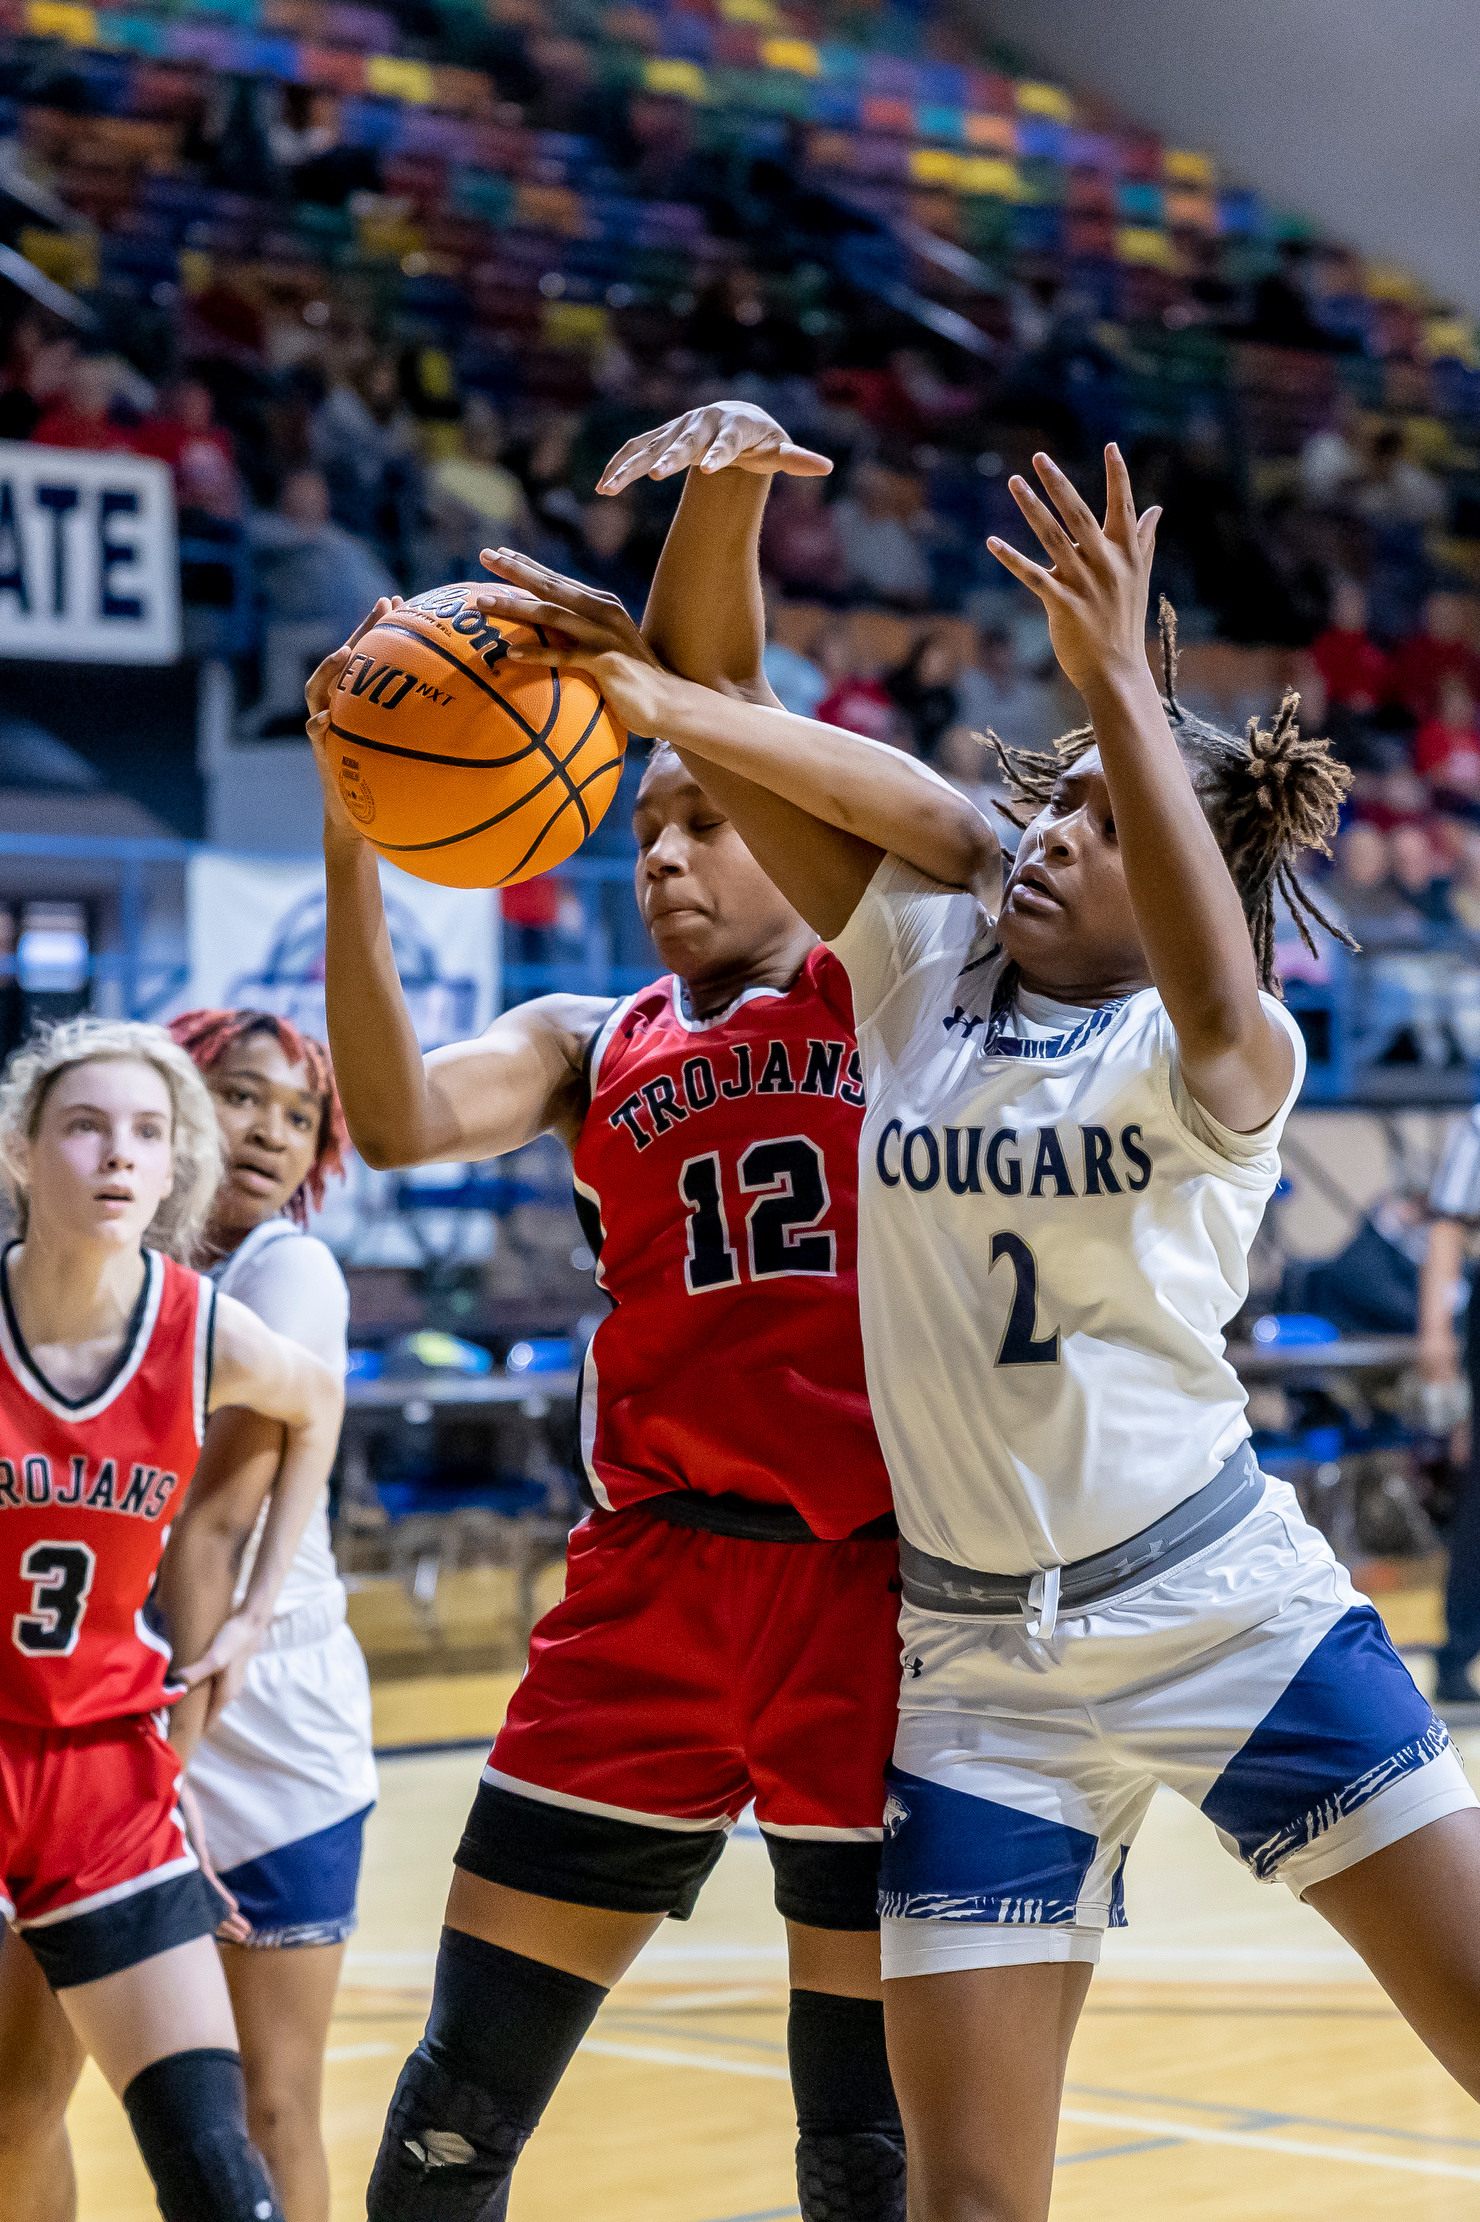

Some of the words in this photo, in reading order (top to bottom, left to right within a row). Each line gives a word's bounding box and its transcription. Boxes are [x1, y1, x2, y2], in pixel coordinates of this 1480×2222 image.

[0, 484, 142, 619] ATE
[336, 653, 419, 710] EVO
[415, 683, 457, 707] NXT
[609, 1038, 866, 1152] TROJANS
[678, 1134, 838, 1296] 12
[876, 1118, 1152, 1198] COUGARS
[988, 1229, 1061, 1368] 2
[0, 1453, 178, 1522] ROJANS
[12, 1540, 97, 1657] 3
